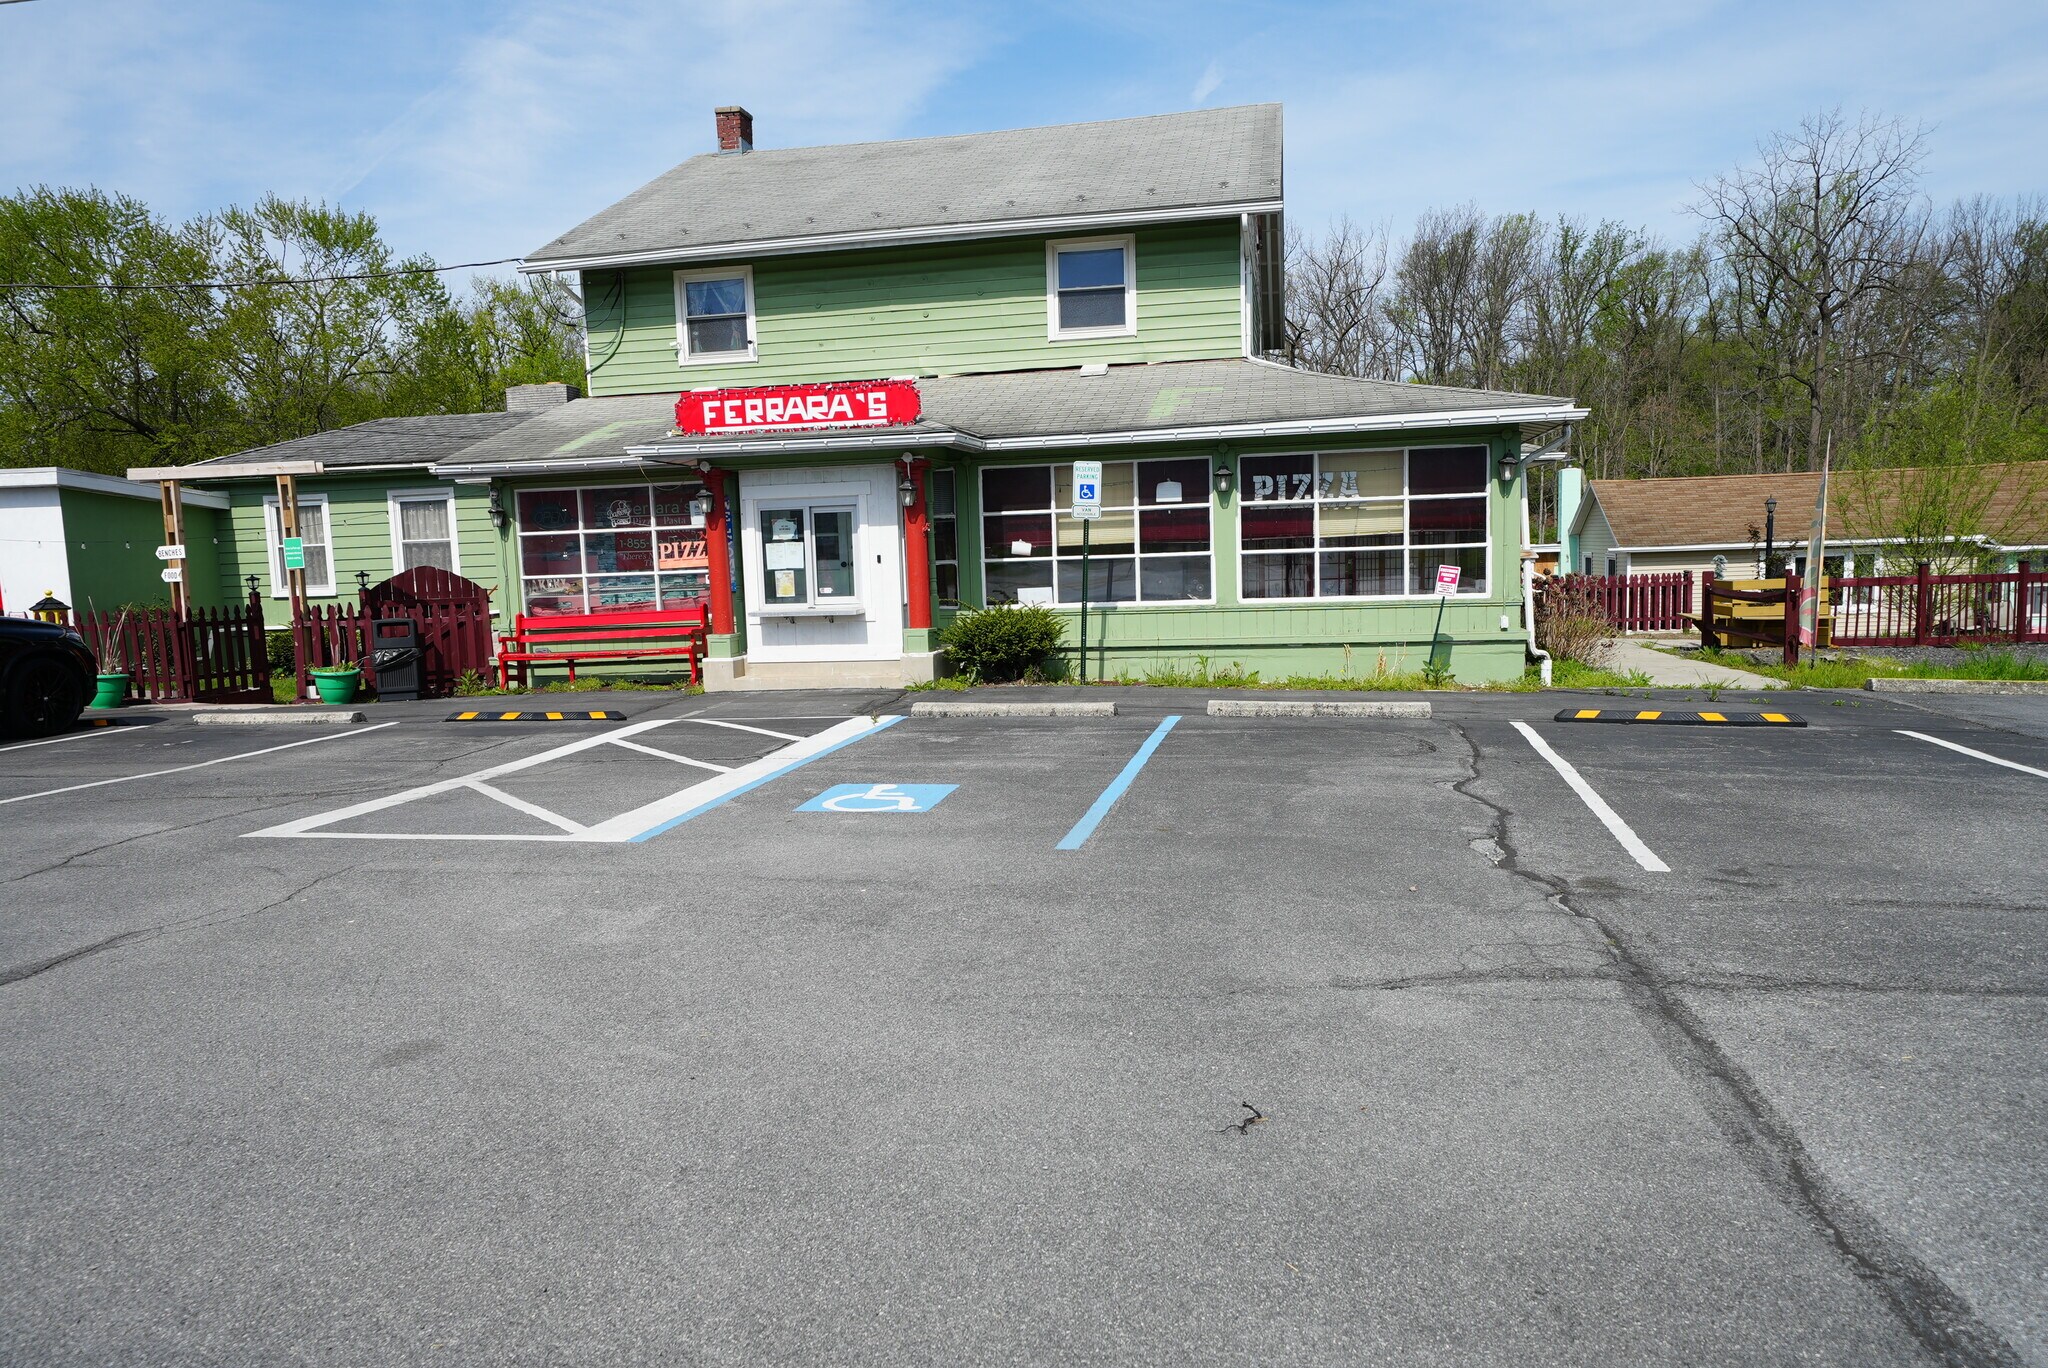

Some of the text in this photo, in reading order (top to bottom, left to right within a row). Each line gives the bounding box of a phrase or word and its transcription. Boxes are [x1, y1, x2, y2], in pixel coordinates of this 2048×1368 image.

[702, 391, 887, 425] FERRARA'S
[1252, 471, 1360, 501] PIZZA
[157, 548, 183, 558] BENCHES
[163, 571, 178, 580] FOOD
